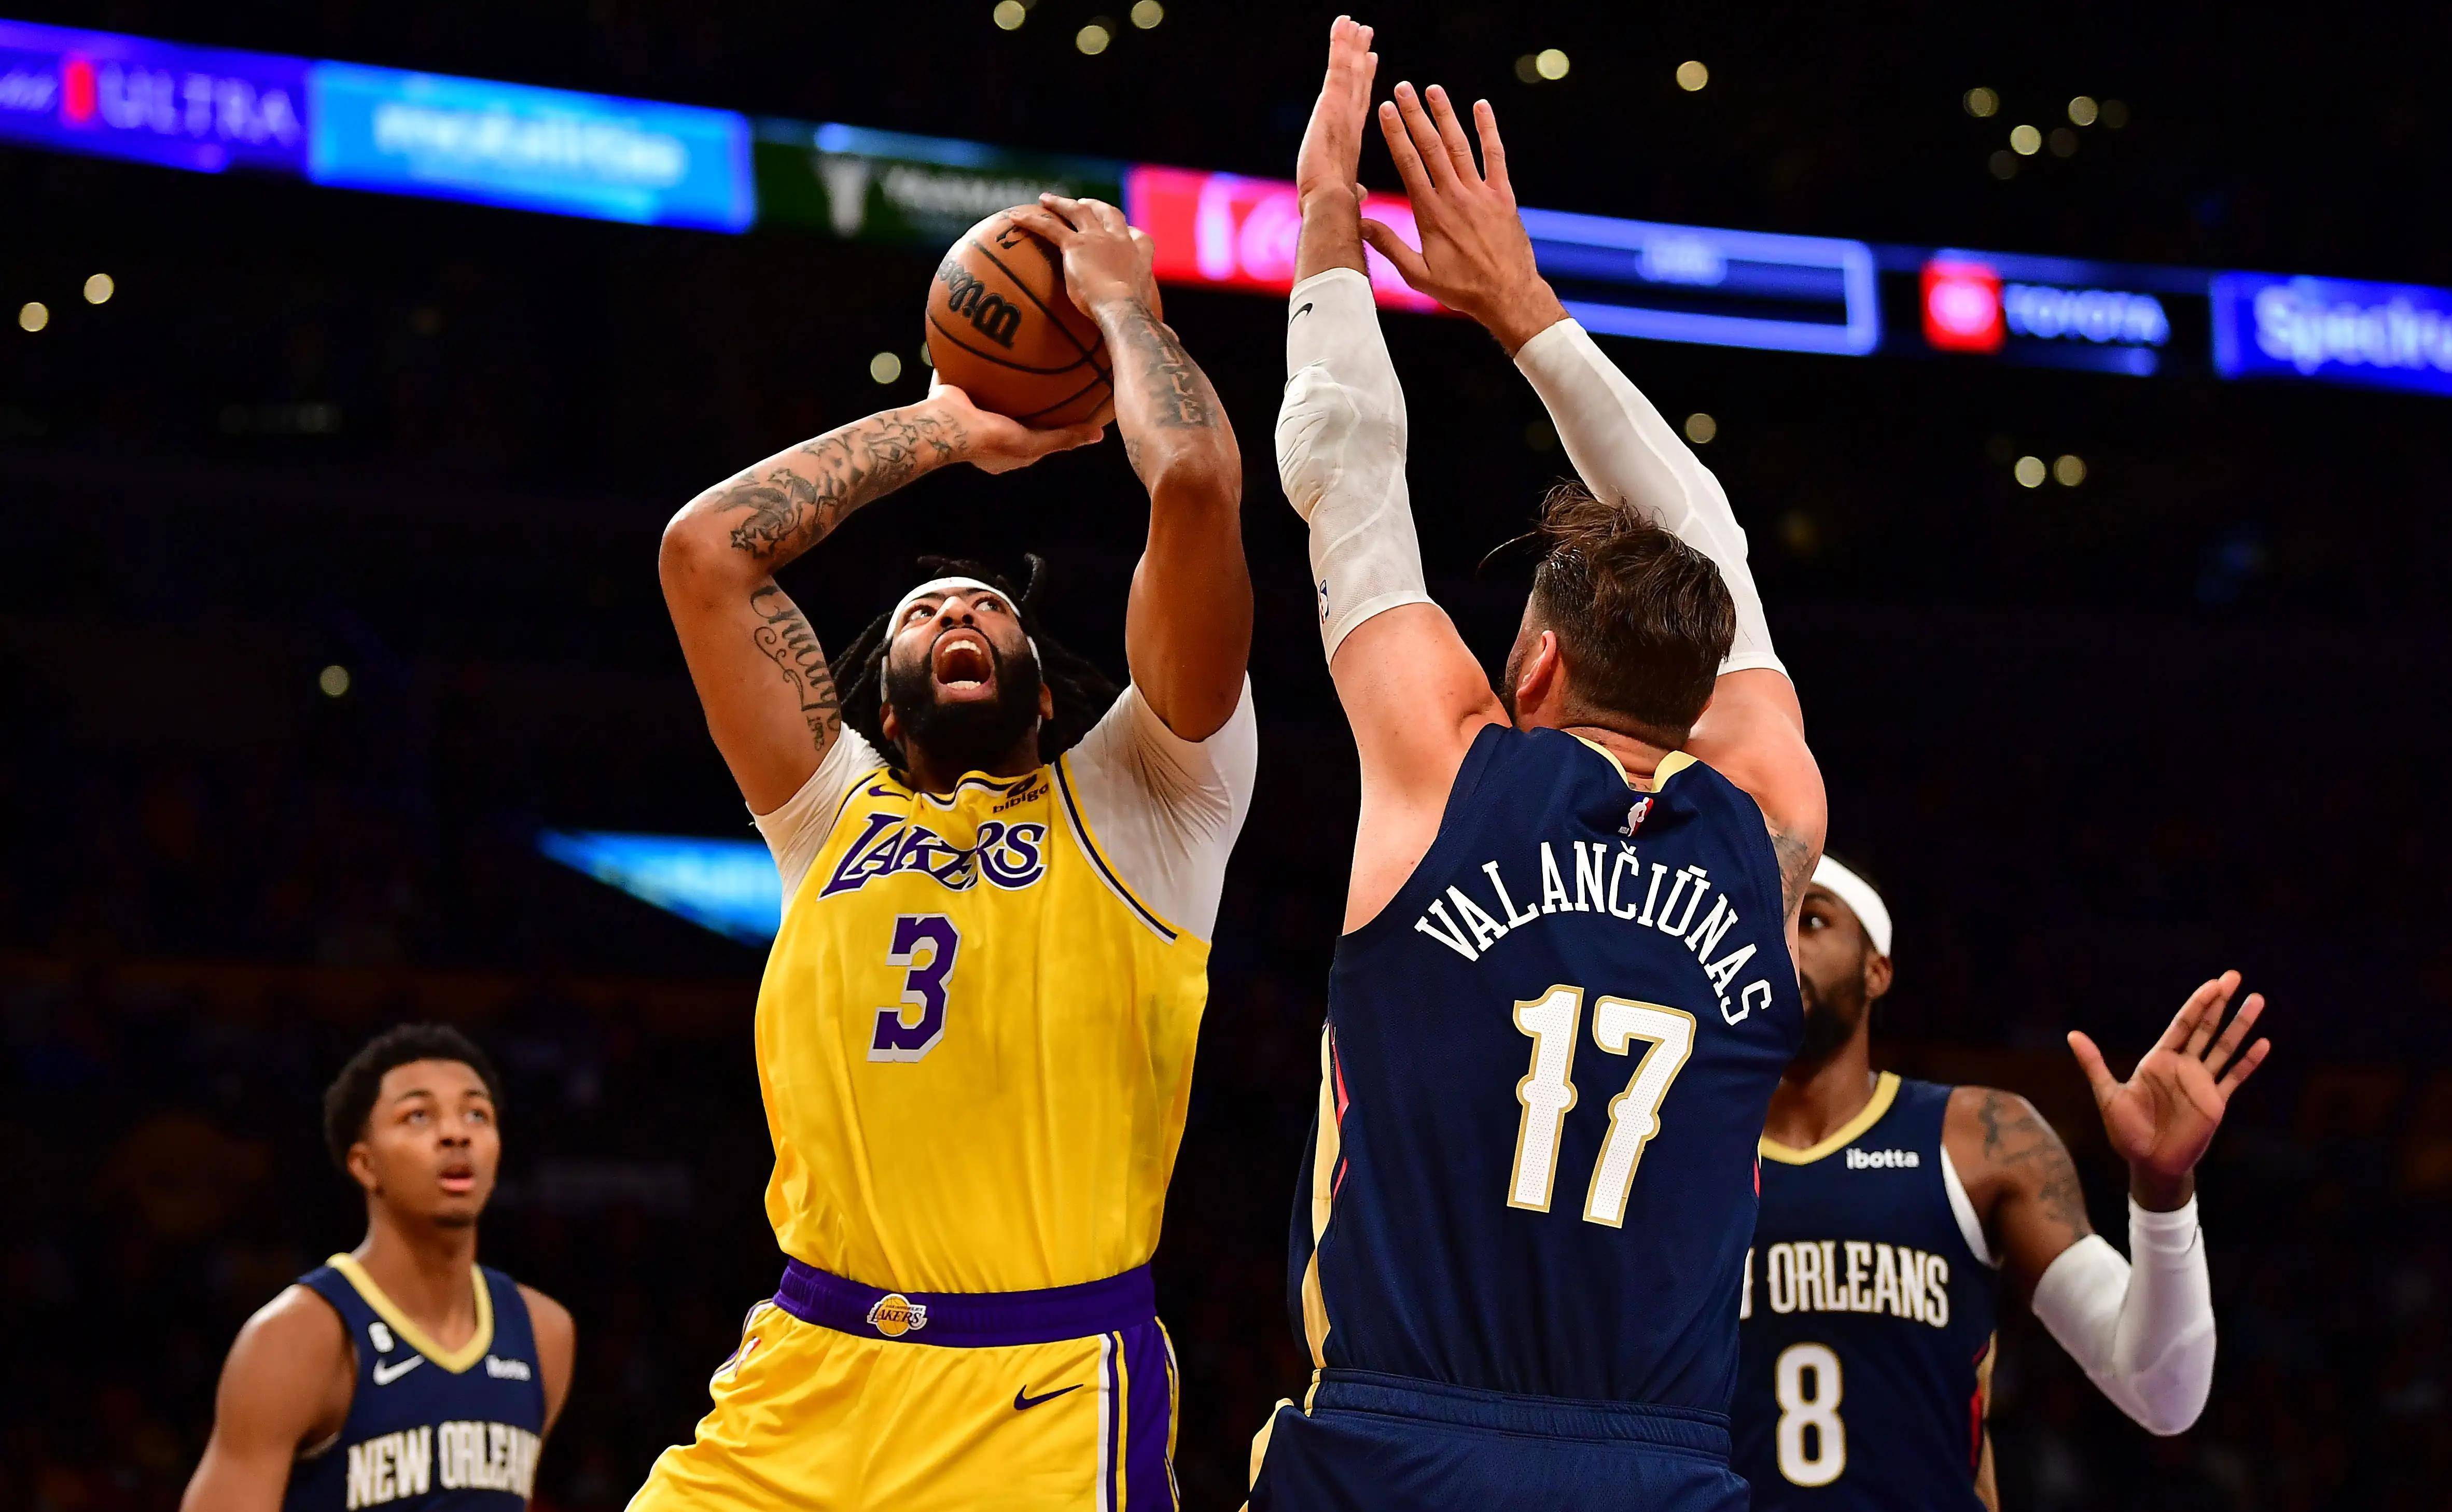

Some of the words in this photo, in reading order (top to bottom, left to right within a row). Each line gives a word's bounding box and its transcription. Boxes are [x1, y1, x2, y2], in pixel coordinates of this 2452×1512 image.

[2003, 283, 2171, 346] TOYOTA
[992, 783, 1049, 814] bibigo
[816, 812, 1049, 902] LAKERS
[1414, 841, 1772, 1026] VALANČIŪNAS
[866, 913, 963, 1063] 3
[1507, 984, 1696, 1229] 17
[1846, 1147, 1919, 1170] ibotta
[870, 1303, 927, 1329] LAKERS
[1766, 1239, 1949, 1328] ORLEANS
[1775, 1341, 1847, 1487] 8
[346, 1424, 432, 1511] NEW
[438, 1419, 542, 1499] ORLEAN
